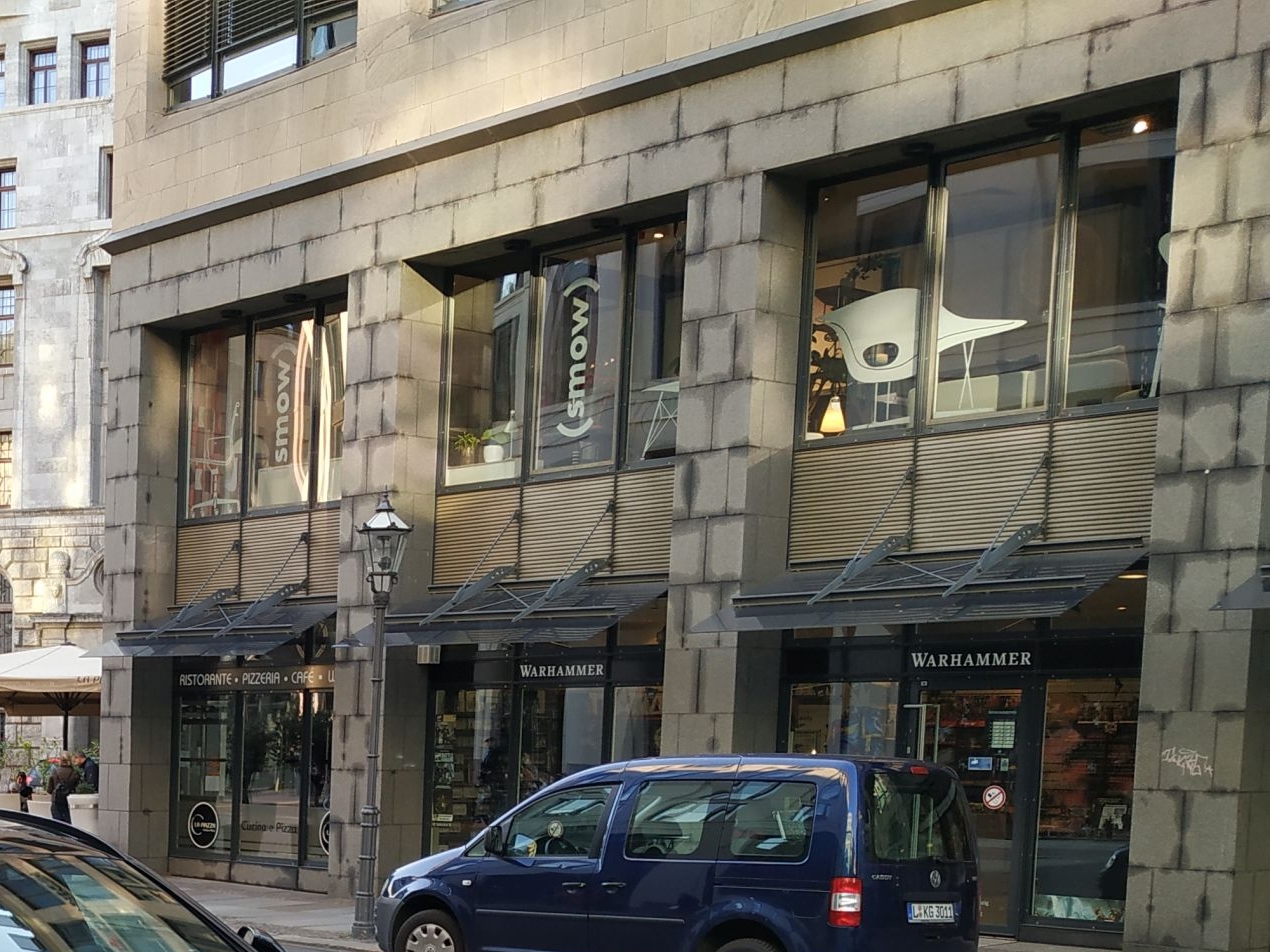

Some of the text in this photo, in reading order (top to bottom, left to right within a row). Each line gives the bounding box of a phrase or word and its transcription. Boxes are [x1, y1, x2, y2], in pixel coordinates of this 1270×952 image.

[180, 673, 232, 686] RISTORANTE
[242, 672, 280, 684] PIZZERIA
[912, 905, 953, 919] L KG 3011
